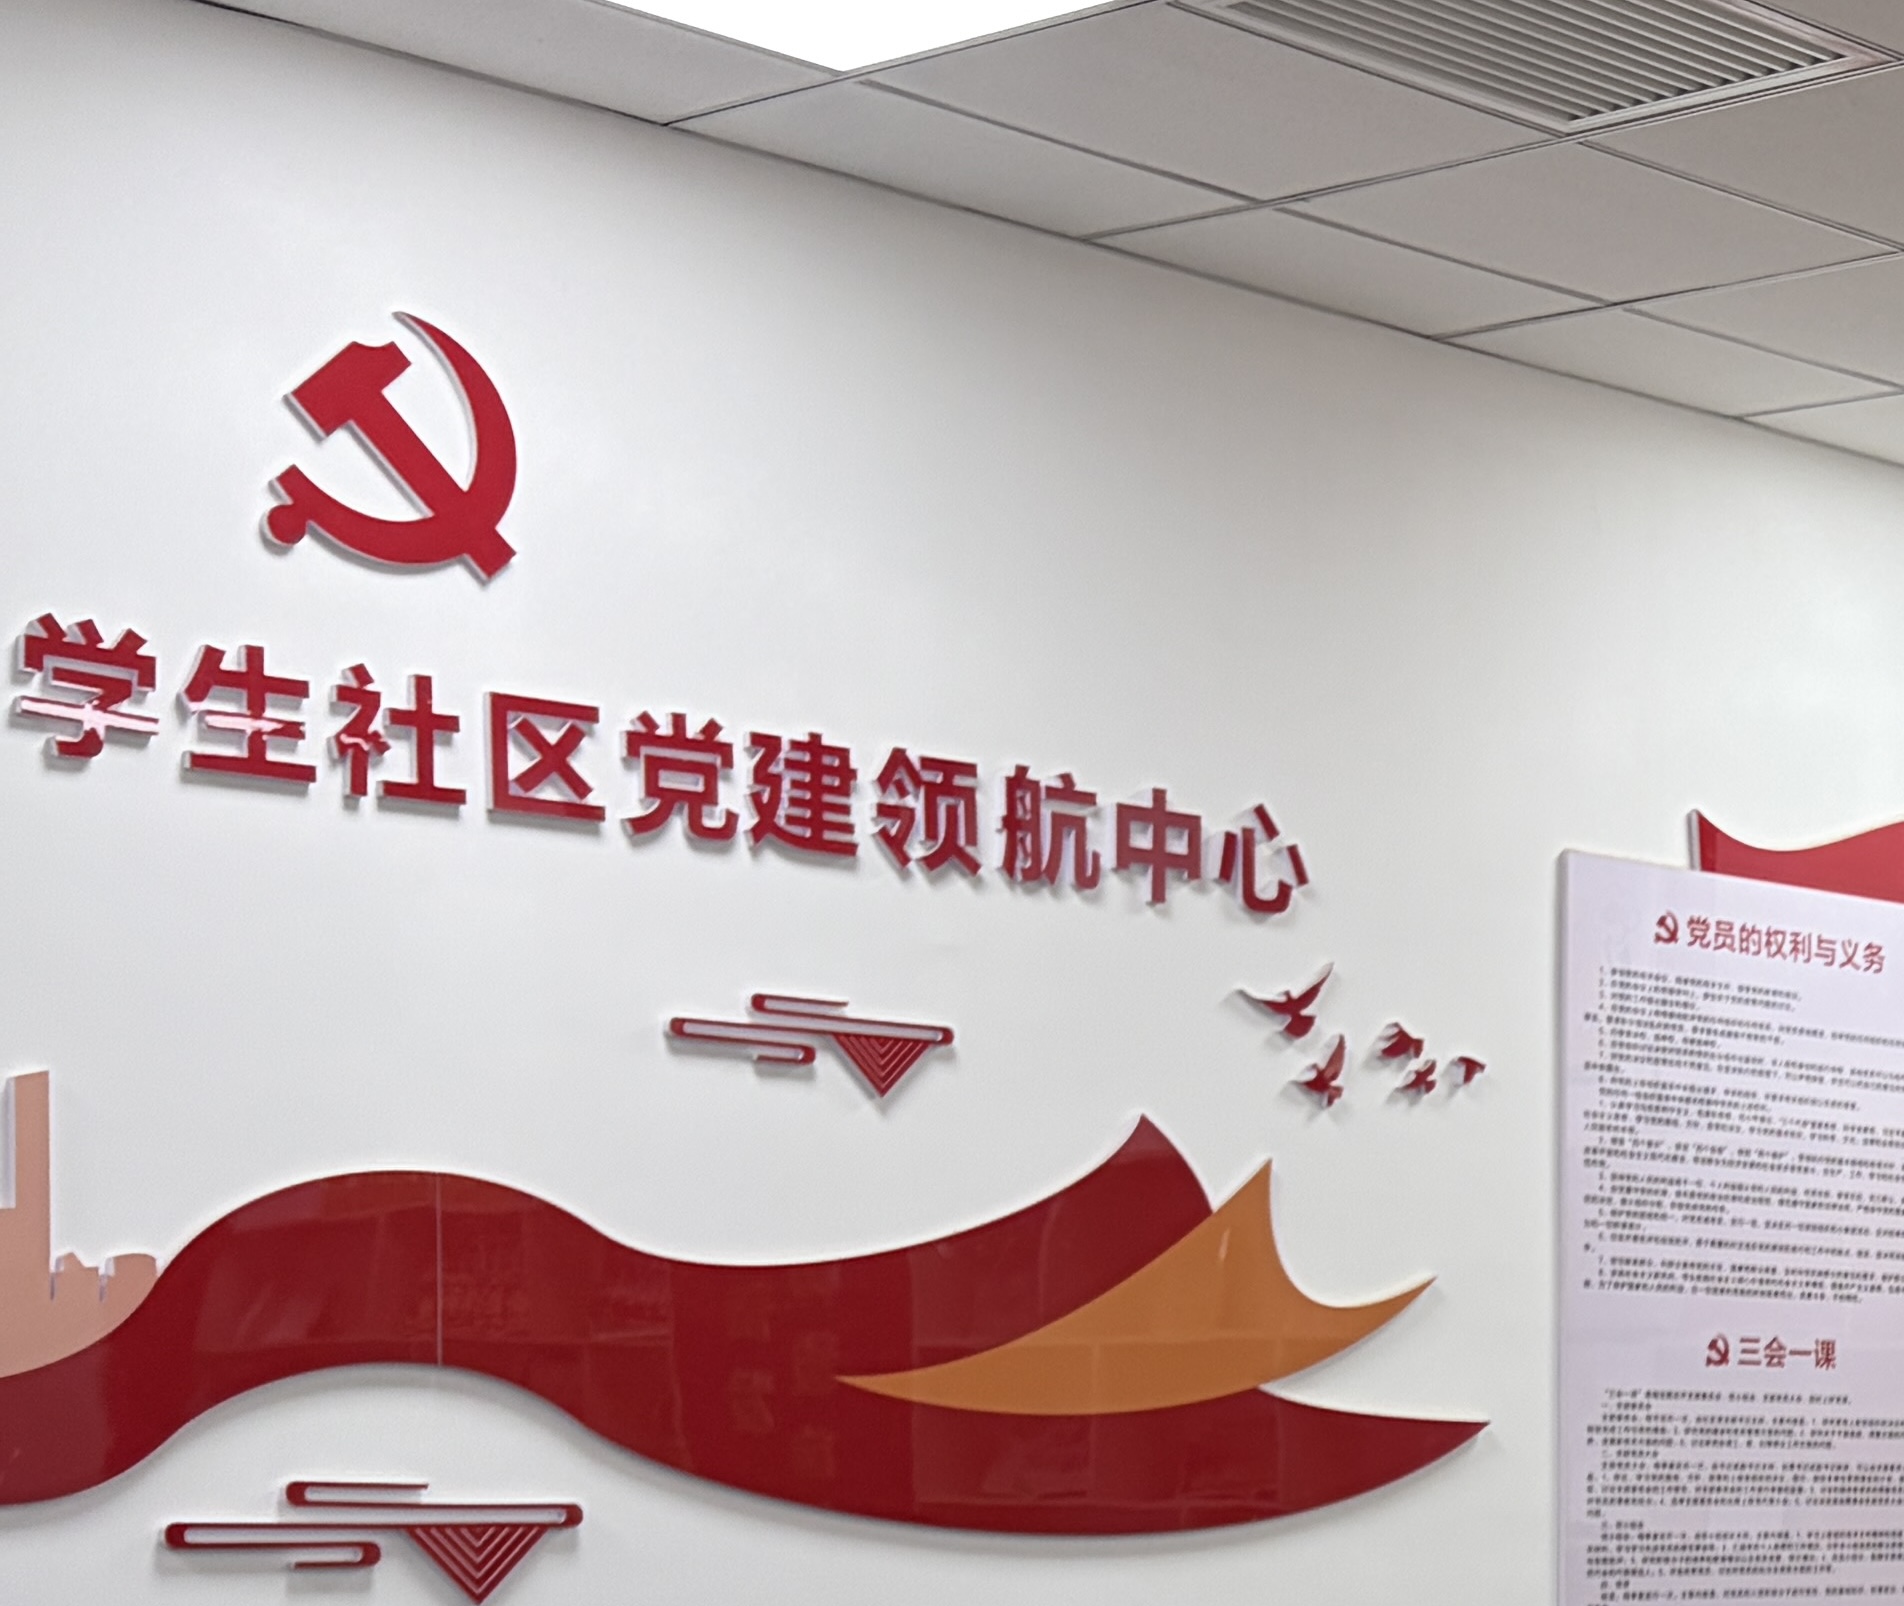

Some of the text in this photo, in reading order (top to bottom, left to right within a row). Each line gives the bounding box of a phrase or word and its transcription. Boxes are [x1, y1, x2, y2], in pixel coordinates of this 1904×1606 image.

[16, 612, 1311, 916] 学生社区党建领航中心
[1686, 913, 1886, 975] 党员的权利与义务
[1737, 1337, 1838, 1371] 三会一课
